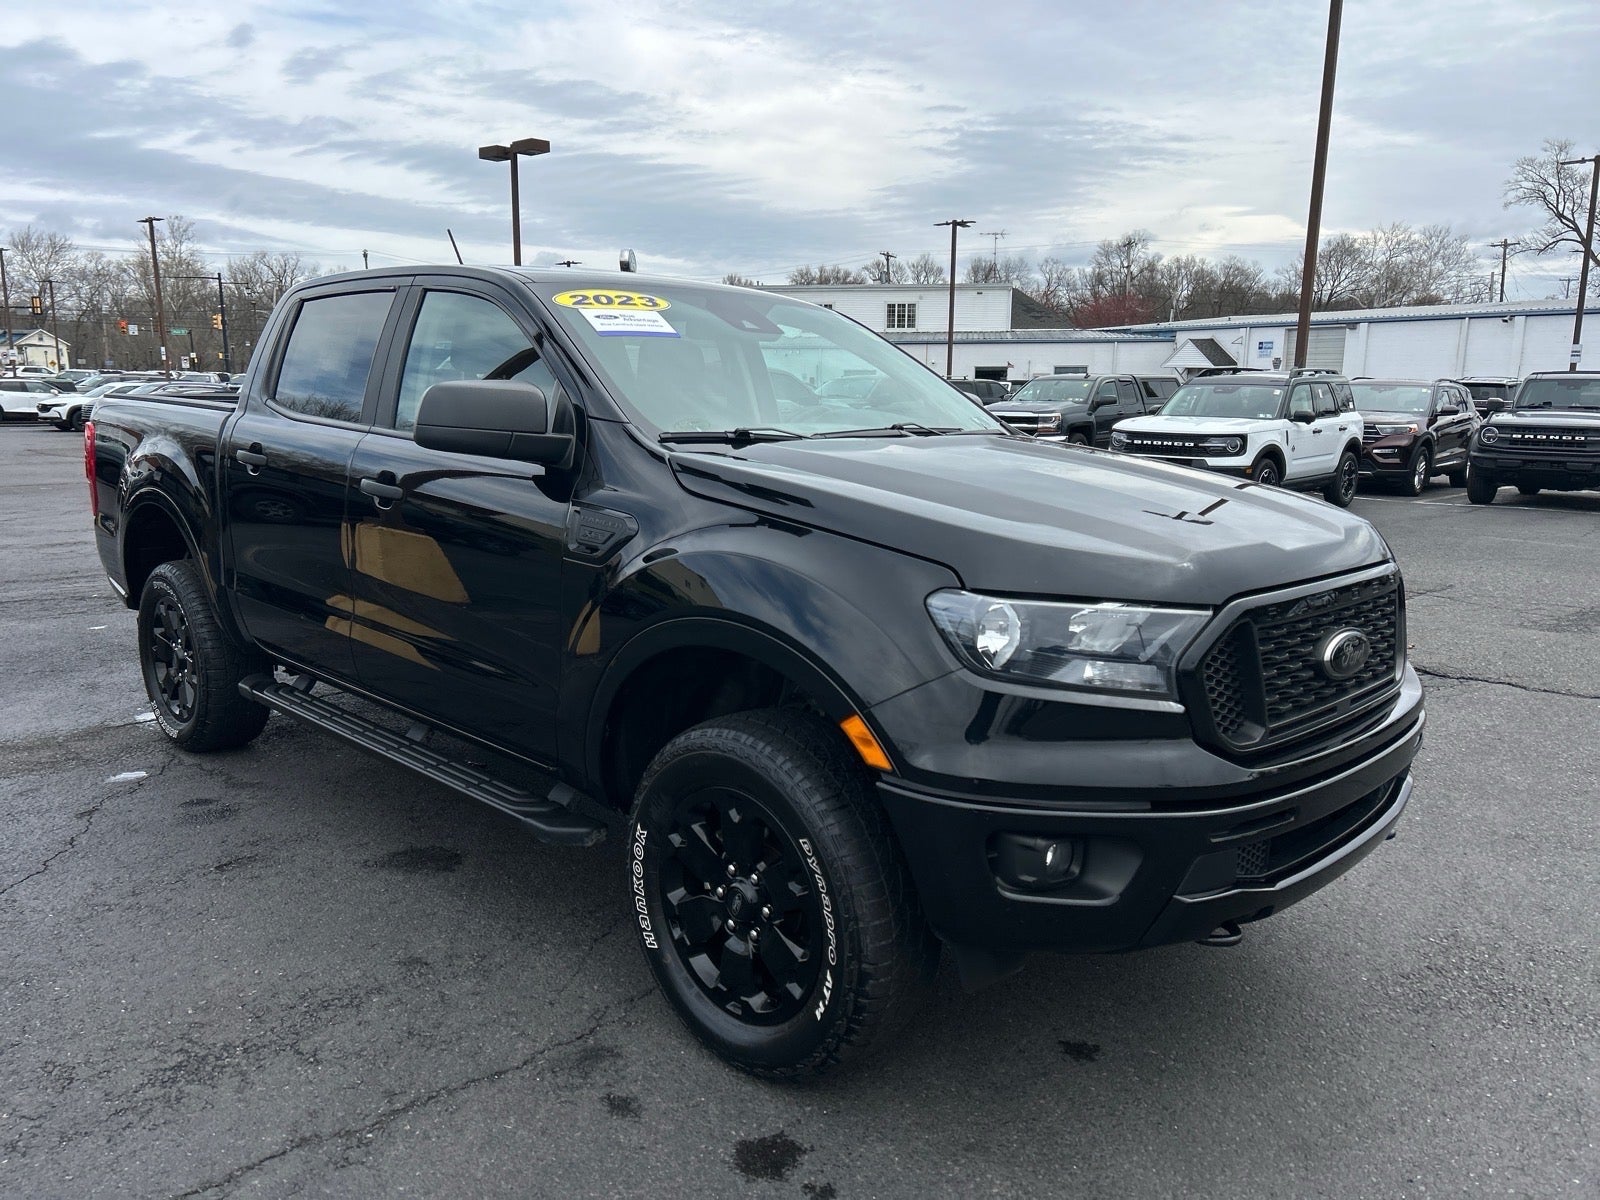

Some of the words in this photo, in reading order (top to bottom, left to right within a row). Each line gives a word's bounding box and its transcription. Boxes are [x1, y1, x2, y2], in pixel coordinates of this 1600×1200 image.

[569, 294, 660, 307] 2023
[1133, 439, 1195, 447] BRONCO
[632, 822, 658, 949] Hankook
